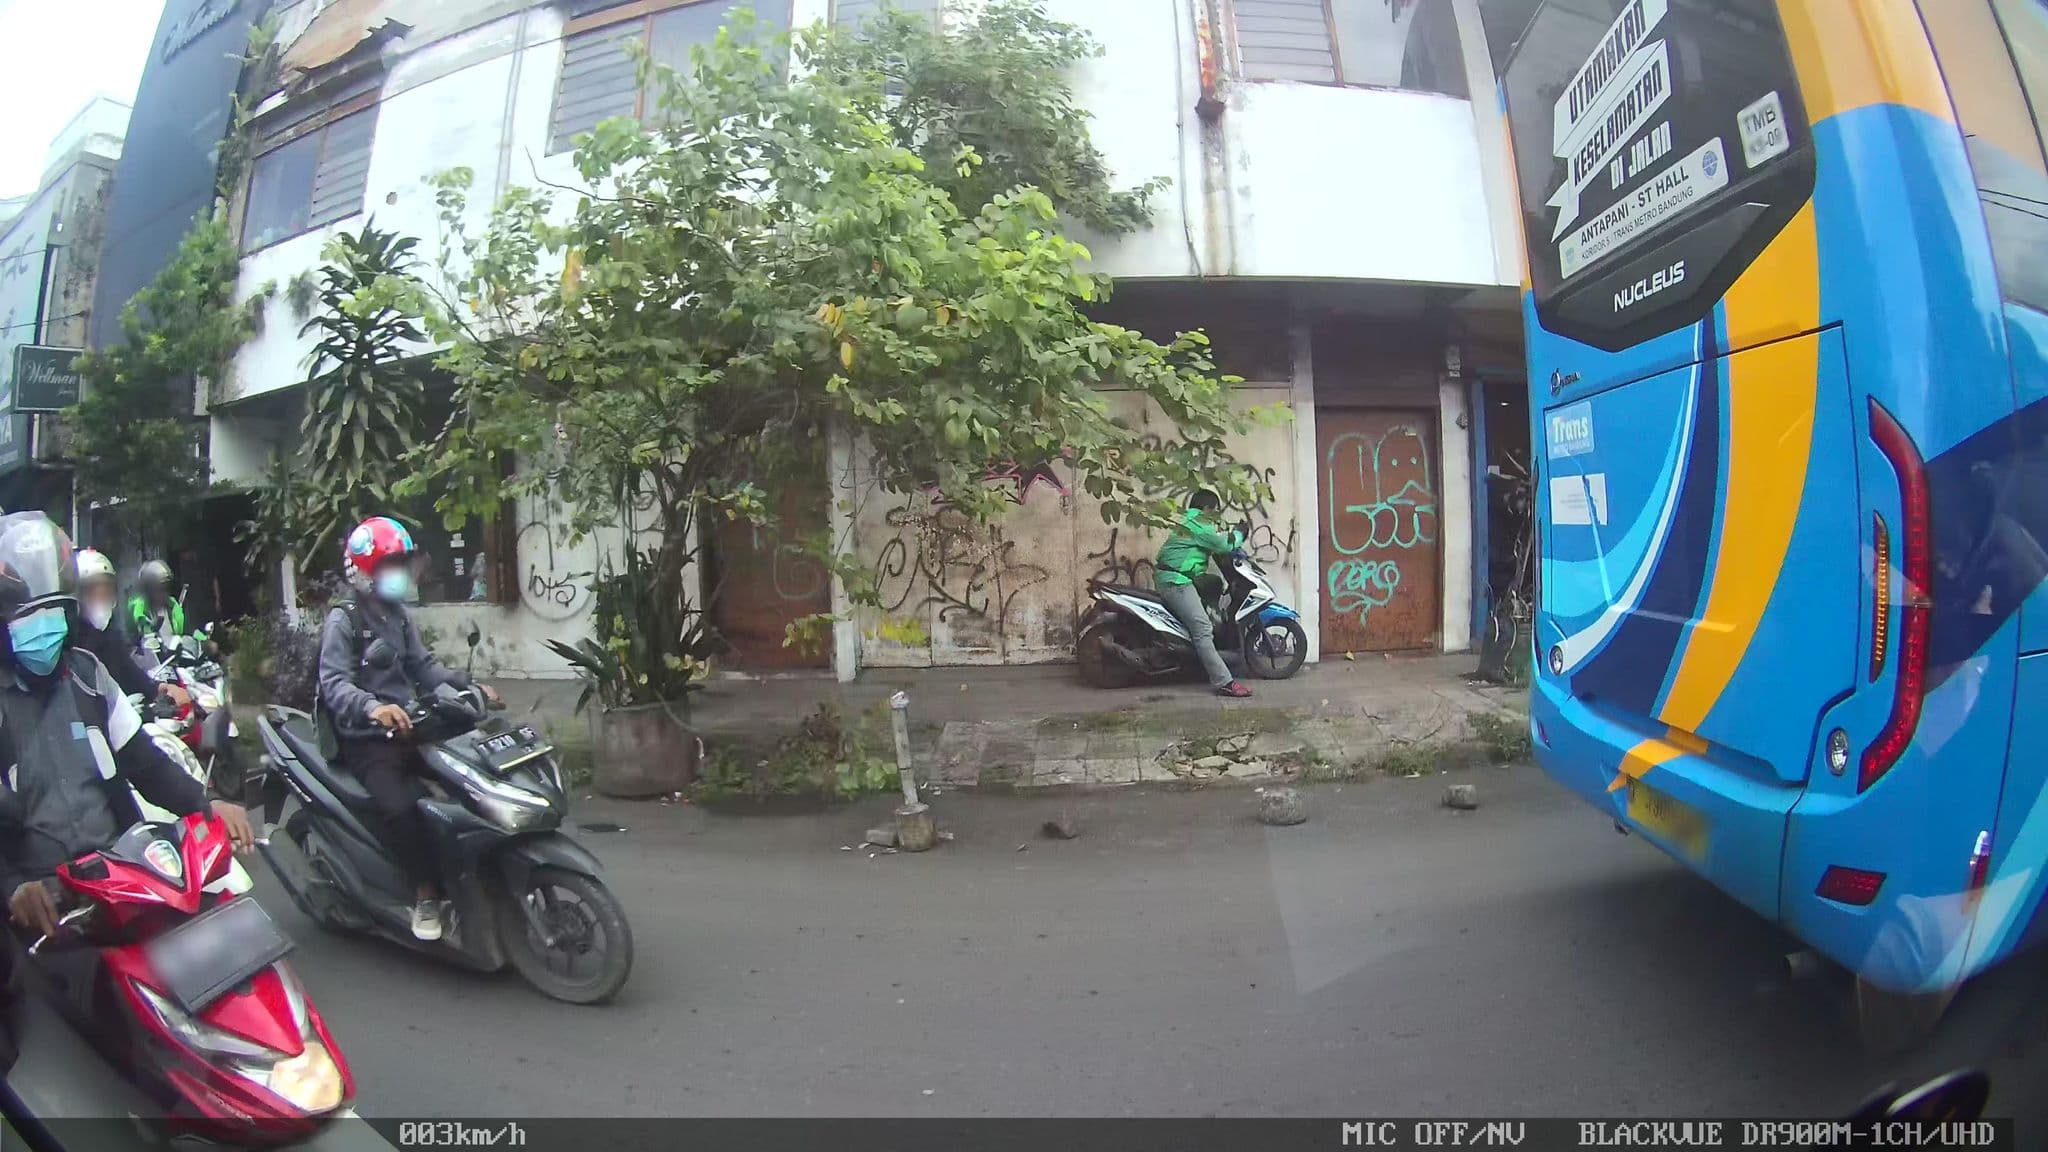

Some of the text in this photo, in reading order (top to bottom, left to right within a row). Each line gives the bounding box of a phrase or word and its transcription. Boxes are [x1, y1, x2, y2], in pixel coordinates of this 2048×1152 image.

[1568, 0, 1647, 125] UTAMAKAN
[1573, 59, 1663, 188] KESELAMATAN
[1610, 120, 1672, 190] DI JALAN
[1581, 202, 1630, 246] ANTAPANI
[1637, 187, 1653, 208] ST
[1655, 166, 1689, 197] HALL
[1613, 224, 1634, 240] TRANS
[1634, 207, 1657, 228] METRO
[1658, 186, 1694, 214] BANDUNG
[1614, 260, 1685, 313] NUCLEUS
[1552, 416, 1589, 443] Trans
